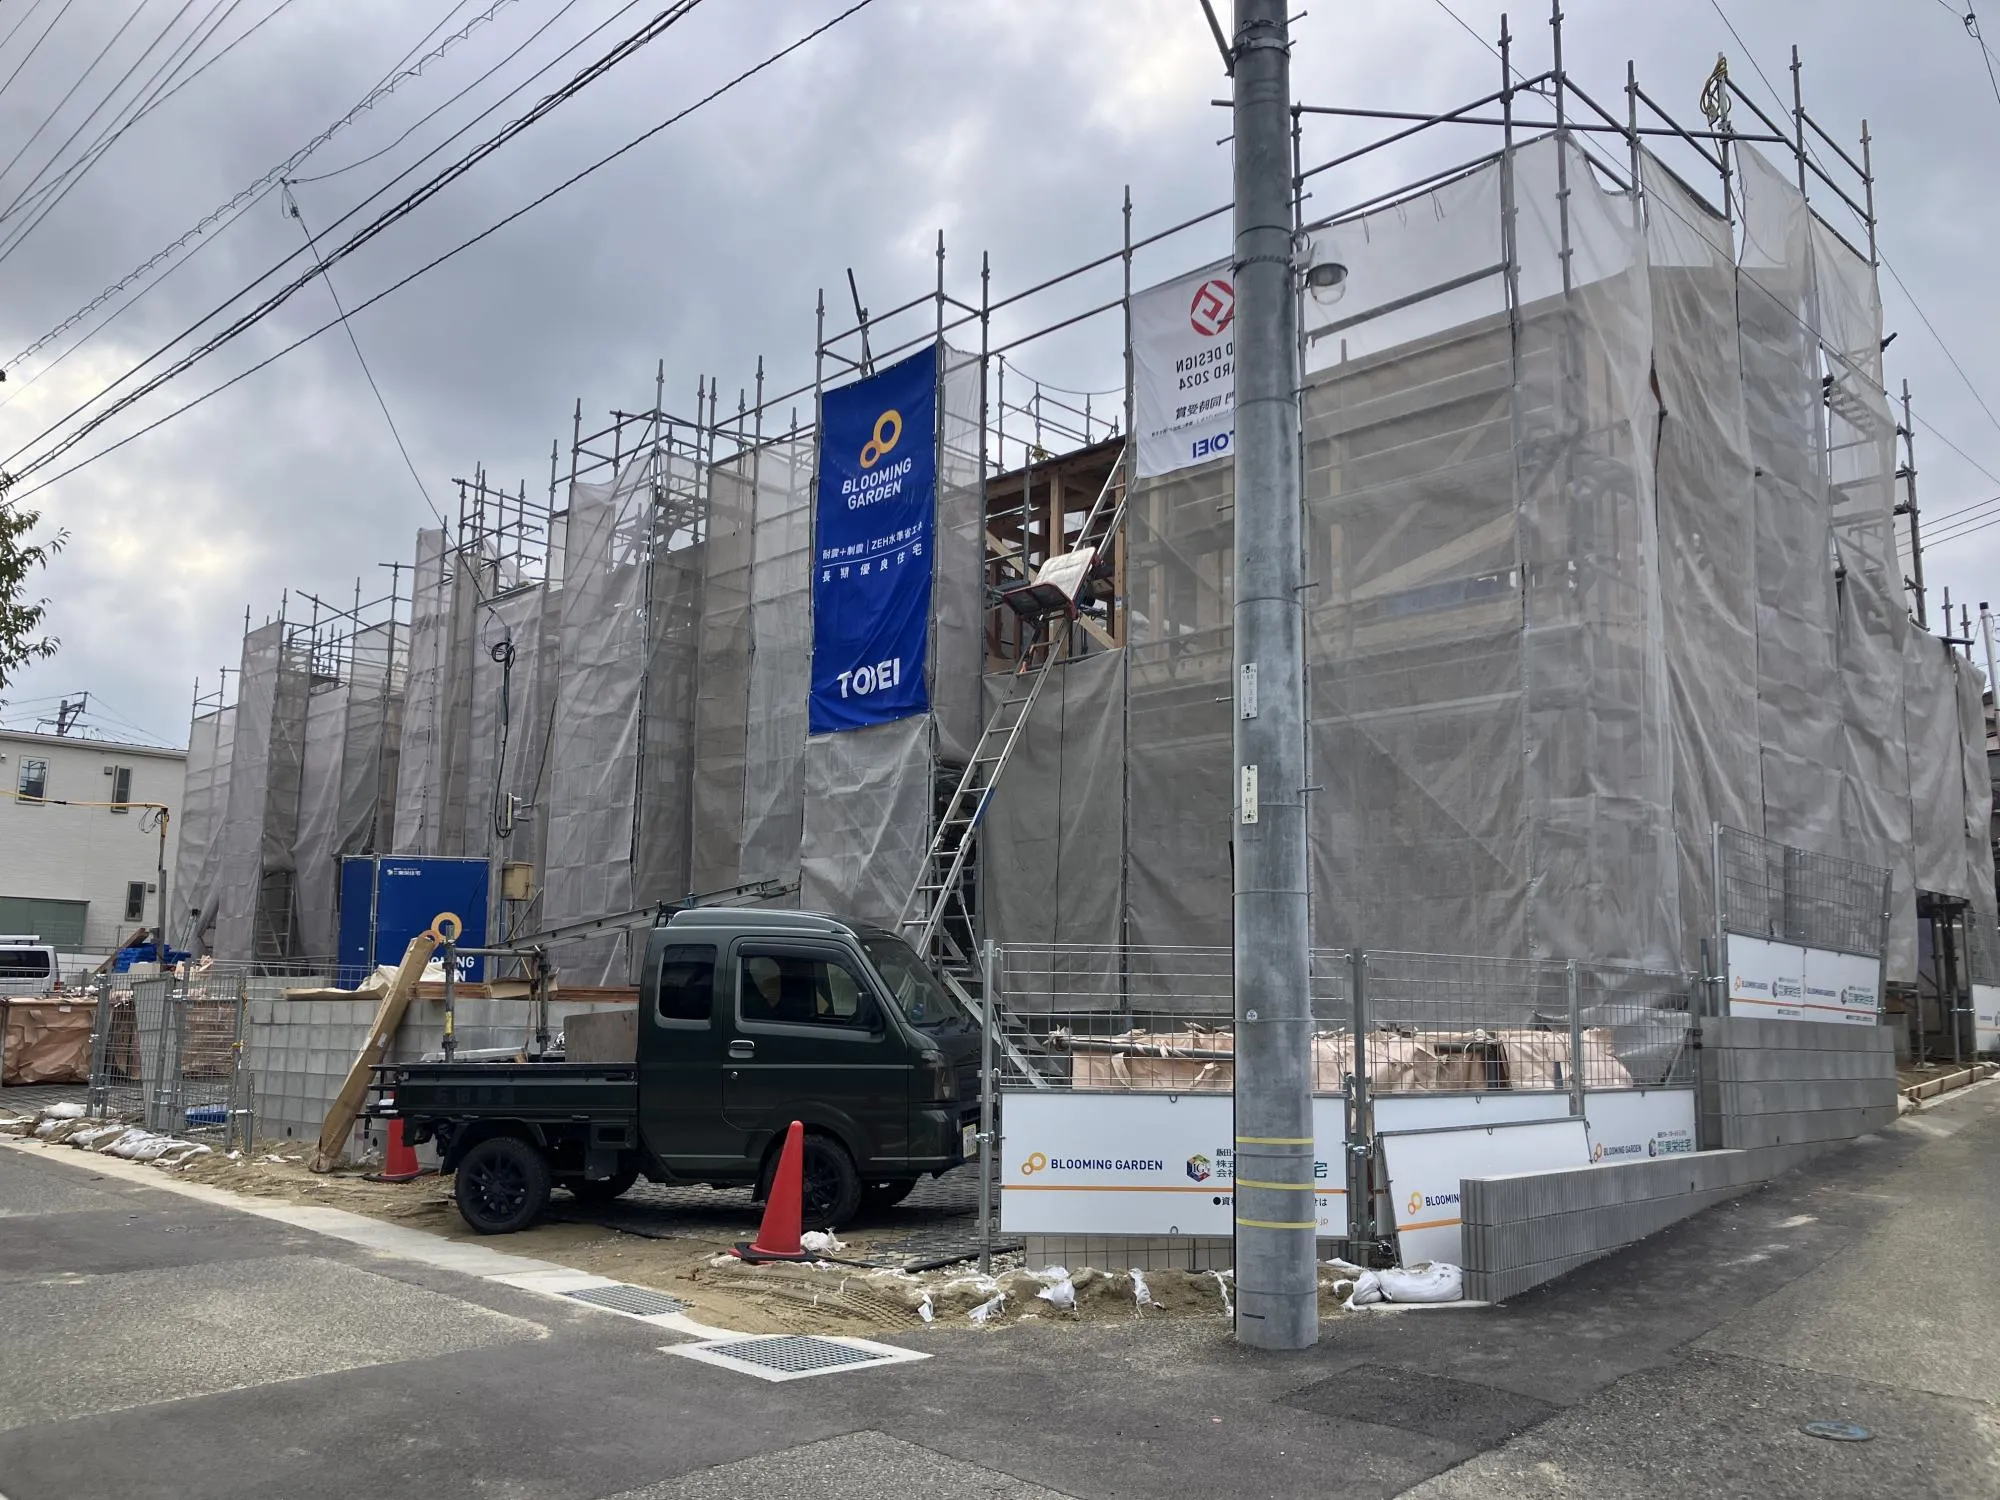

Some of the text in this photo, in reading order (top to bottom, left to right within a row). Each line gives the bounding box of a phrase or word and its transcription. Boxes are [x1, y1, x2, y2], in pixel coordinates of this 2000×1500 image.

[841, 457, 912, 494] BLOOMING
[848, 478, 902, 510] GARDEN
[836, 657, 900, 699] TOEI
[1216, 1148, 1234, 1157] 飯田
[1051, 1158, 1163, 1171] BLOOMING GARDEN
[1425, 1193, 1461, 1207] BLOOMIN
